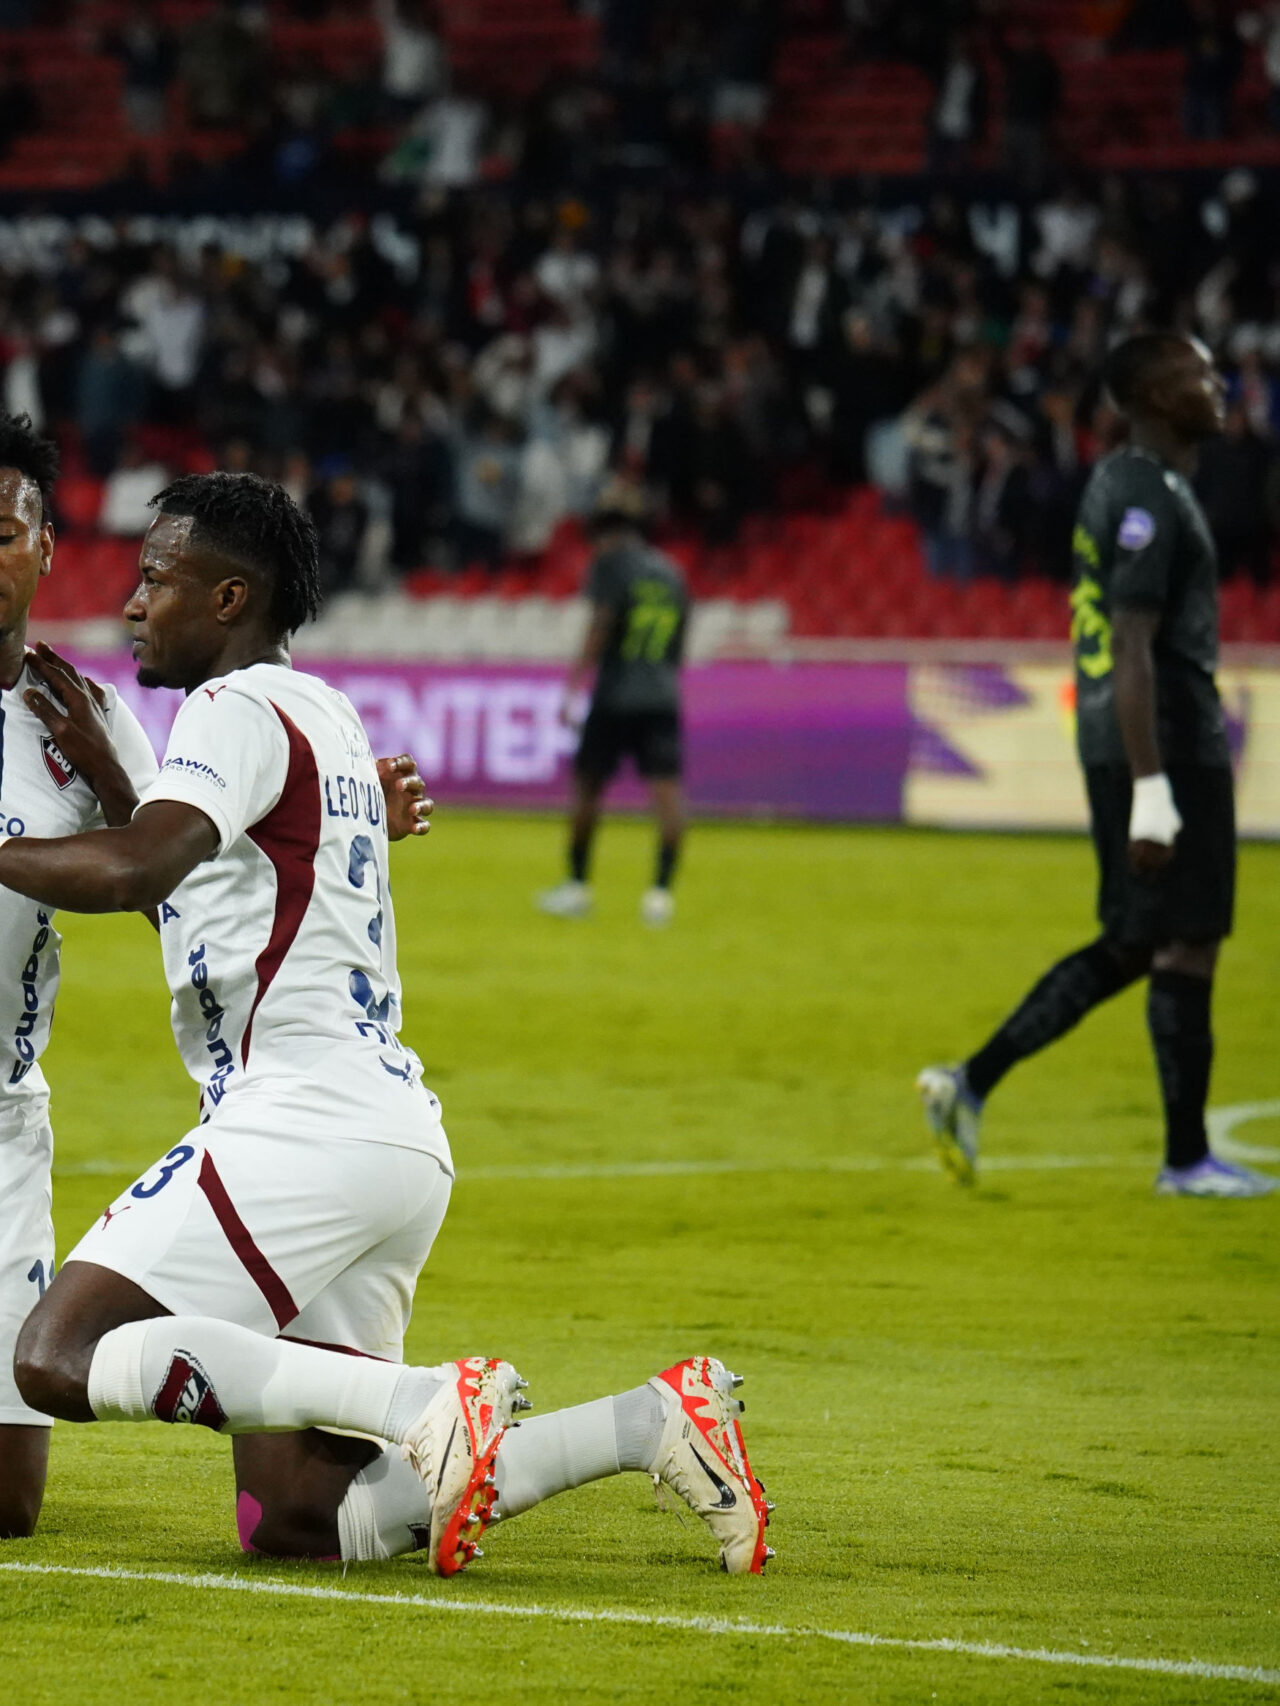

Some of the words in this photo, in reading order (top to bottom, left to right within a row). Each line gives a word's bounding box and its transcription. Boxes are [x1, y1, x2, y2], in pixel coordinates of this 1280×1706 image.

[46, 742, 72, 773] LDU
[8, 909, 50, 1084] Ecuabet
[188, 943, 235, 1106] Ecuabet
